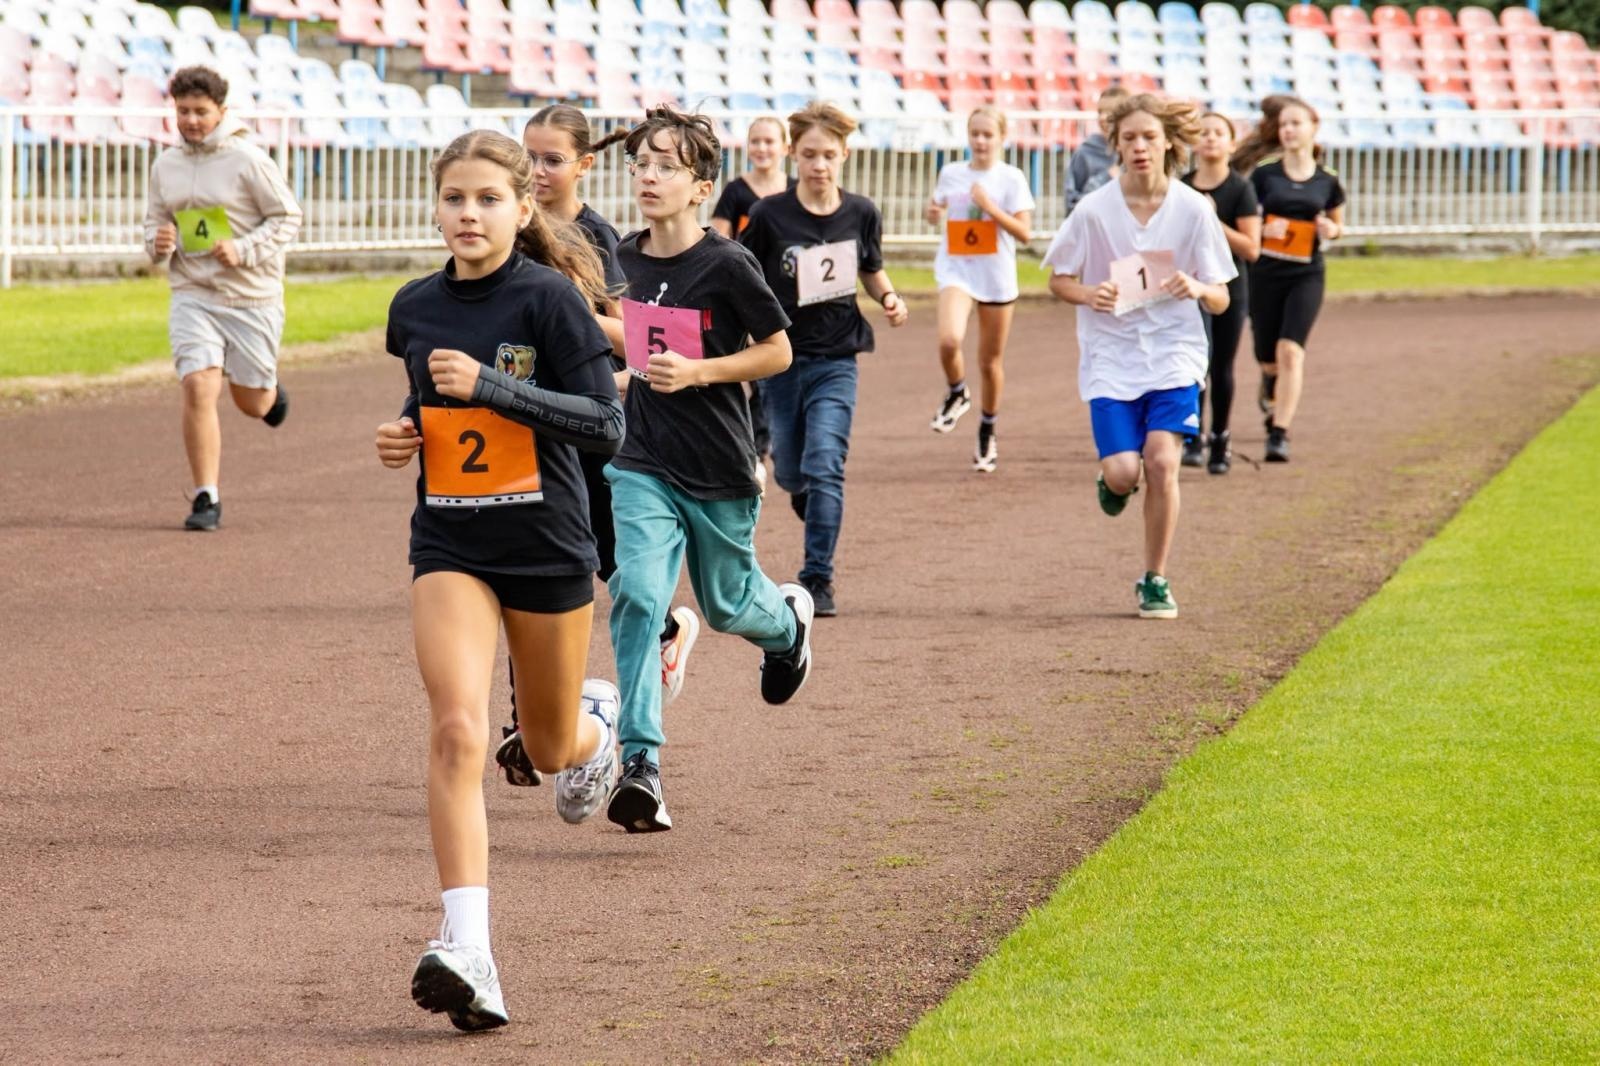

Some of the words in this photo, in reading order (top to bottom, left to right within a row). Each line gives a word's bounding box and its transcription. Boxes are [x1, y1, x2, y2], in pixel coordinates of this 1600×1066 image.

[195, 218, 209, 239] 4
[964, 227, 978, 246] 6
[820, 258, 835, 282] 2
[1137, 266, 1147, 290] 1
[647, 326, 668, 355] 5
[458, 429, 489, 473] 2
